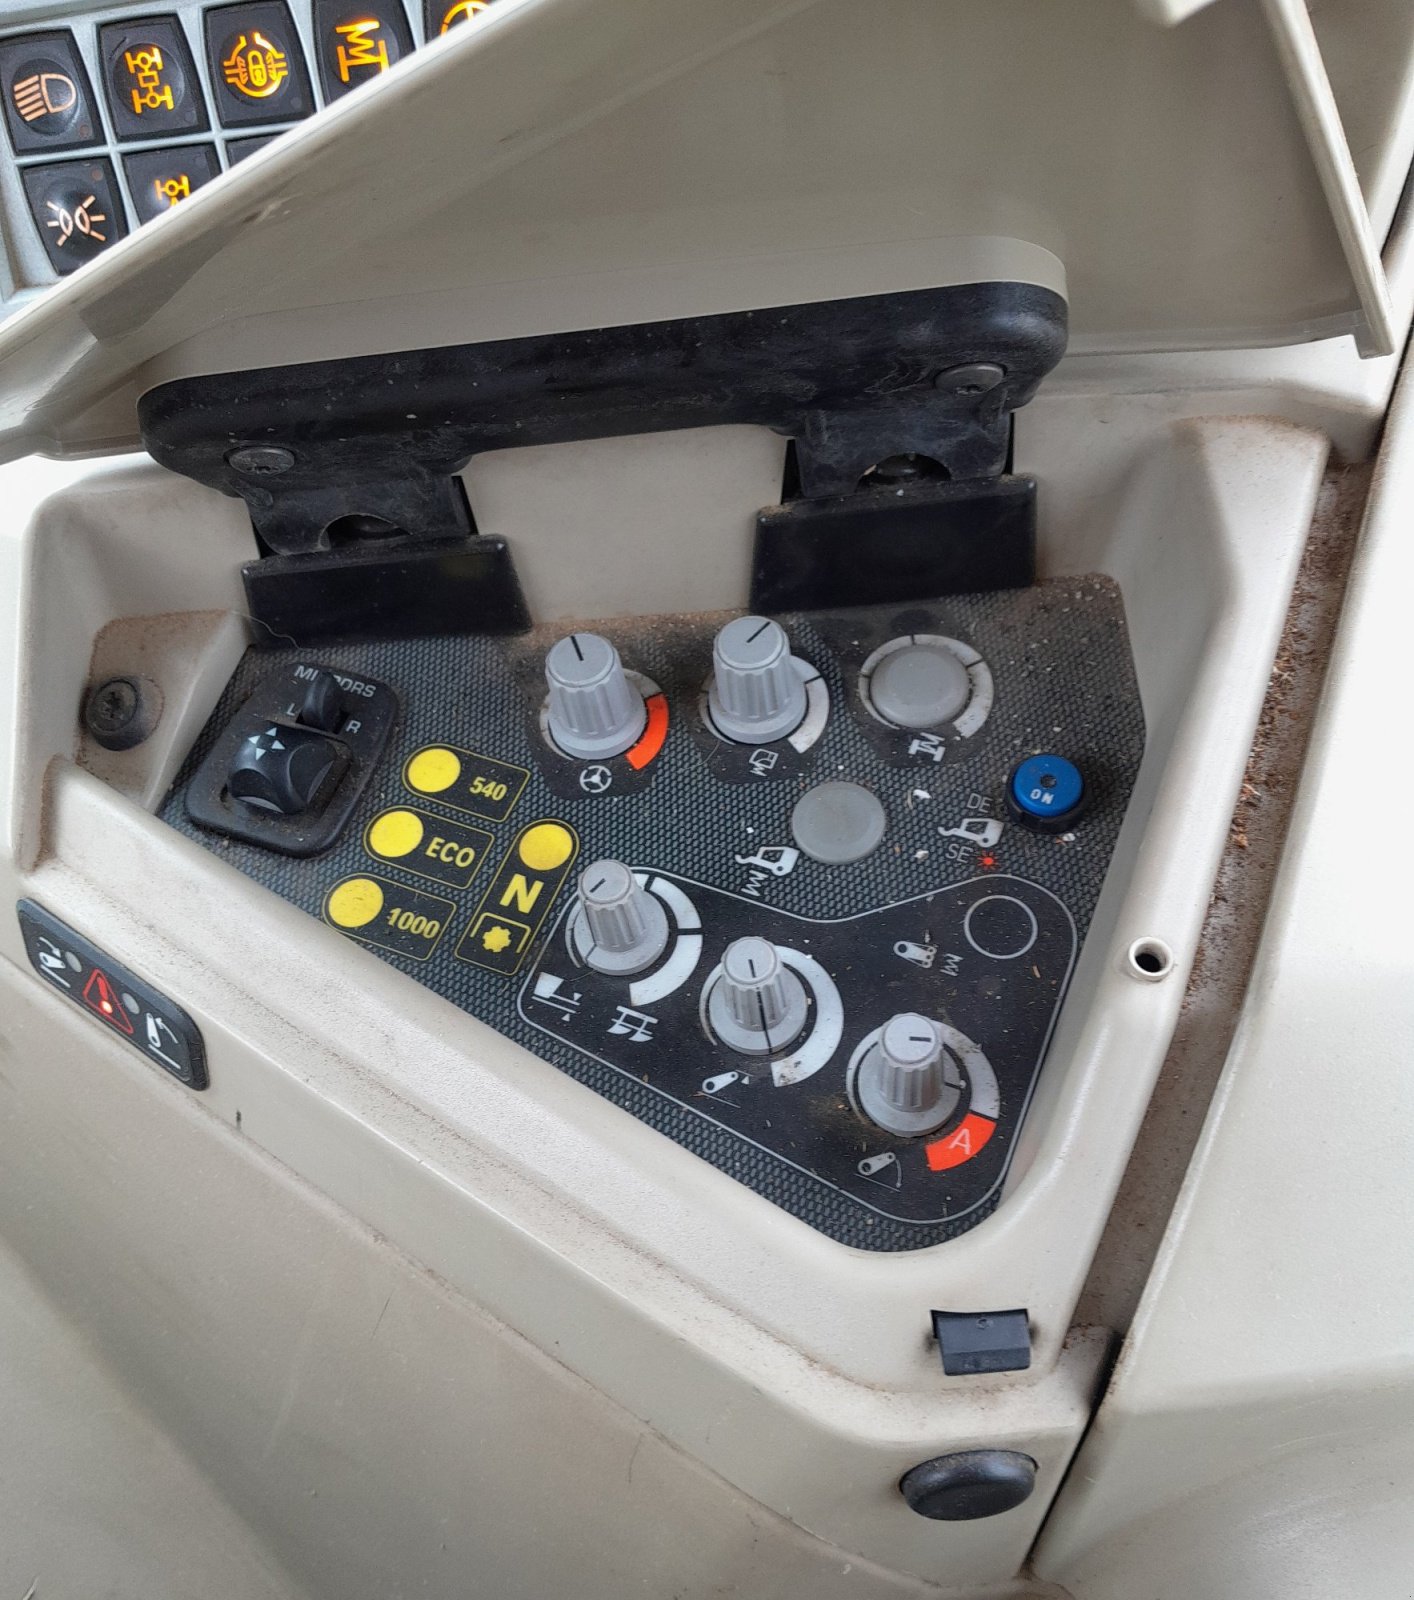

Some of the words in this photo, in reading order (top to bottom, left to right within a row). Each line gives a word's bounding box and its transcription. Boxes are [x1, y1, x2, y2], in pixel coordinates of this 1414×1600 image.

[294, 665, 377, 698] MIORS
[286, 703, 295, 716] L
[346, 720, 361, 734] R
[469, 776, 508, 801] 540
[967, 793, 993, 813] DE
[425, 836, 475, 868] ECO
[945, 843, 974, 863] SE
[500, 874, 544, 914] N
[386, 907, 440, 939] 1000
[948, 1128, 972, 1155] A
